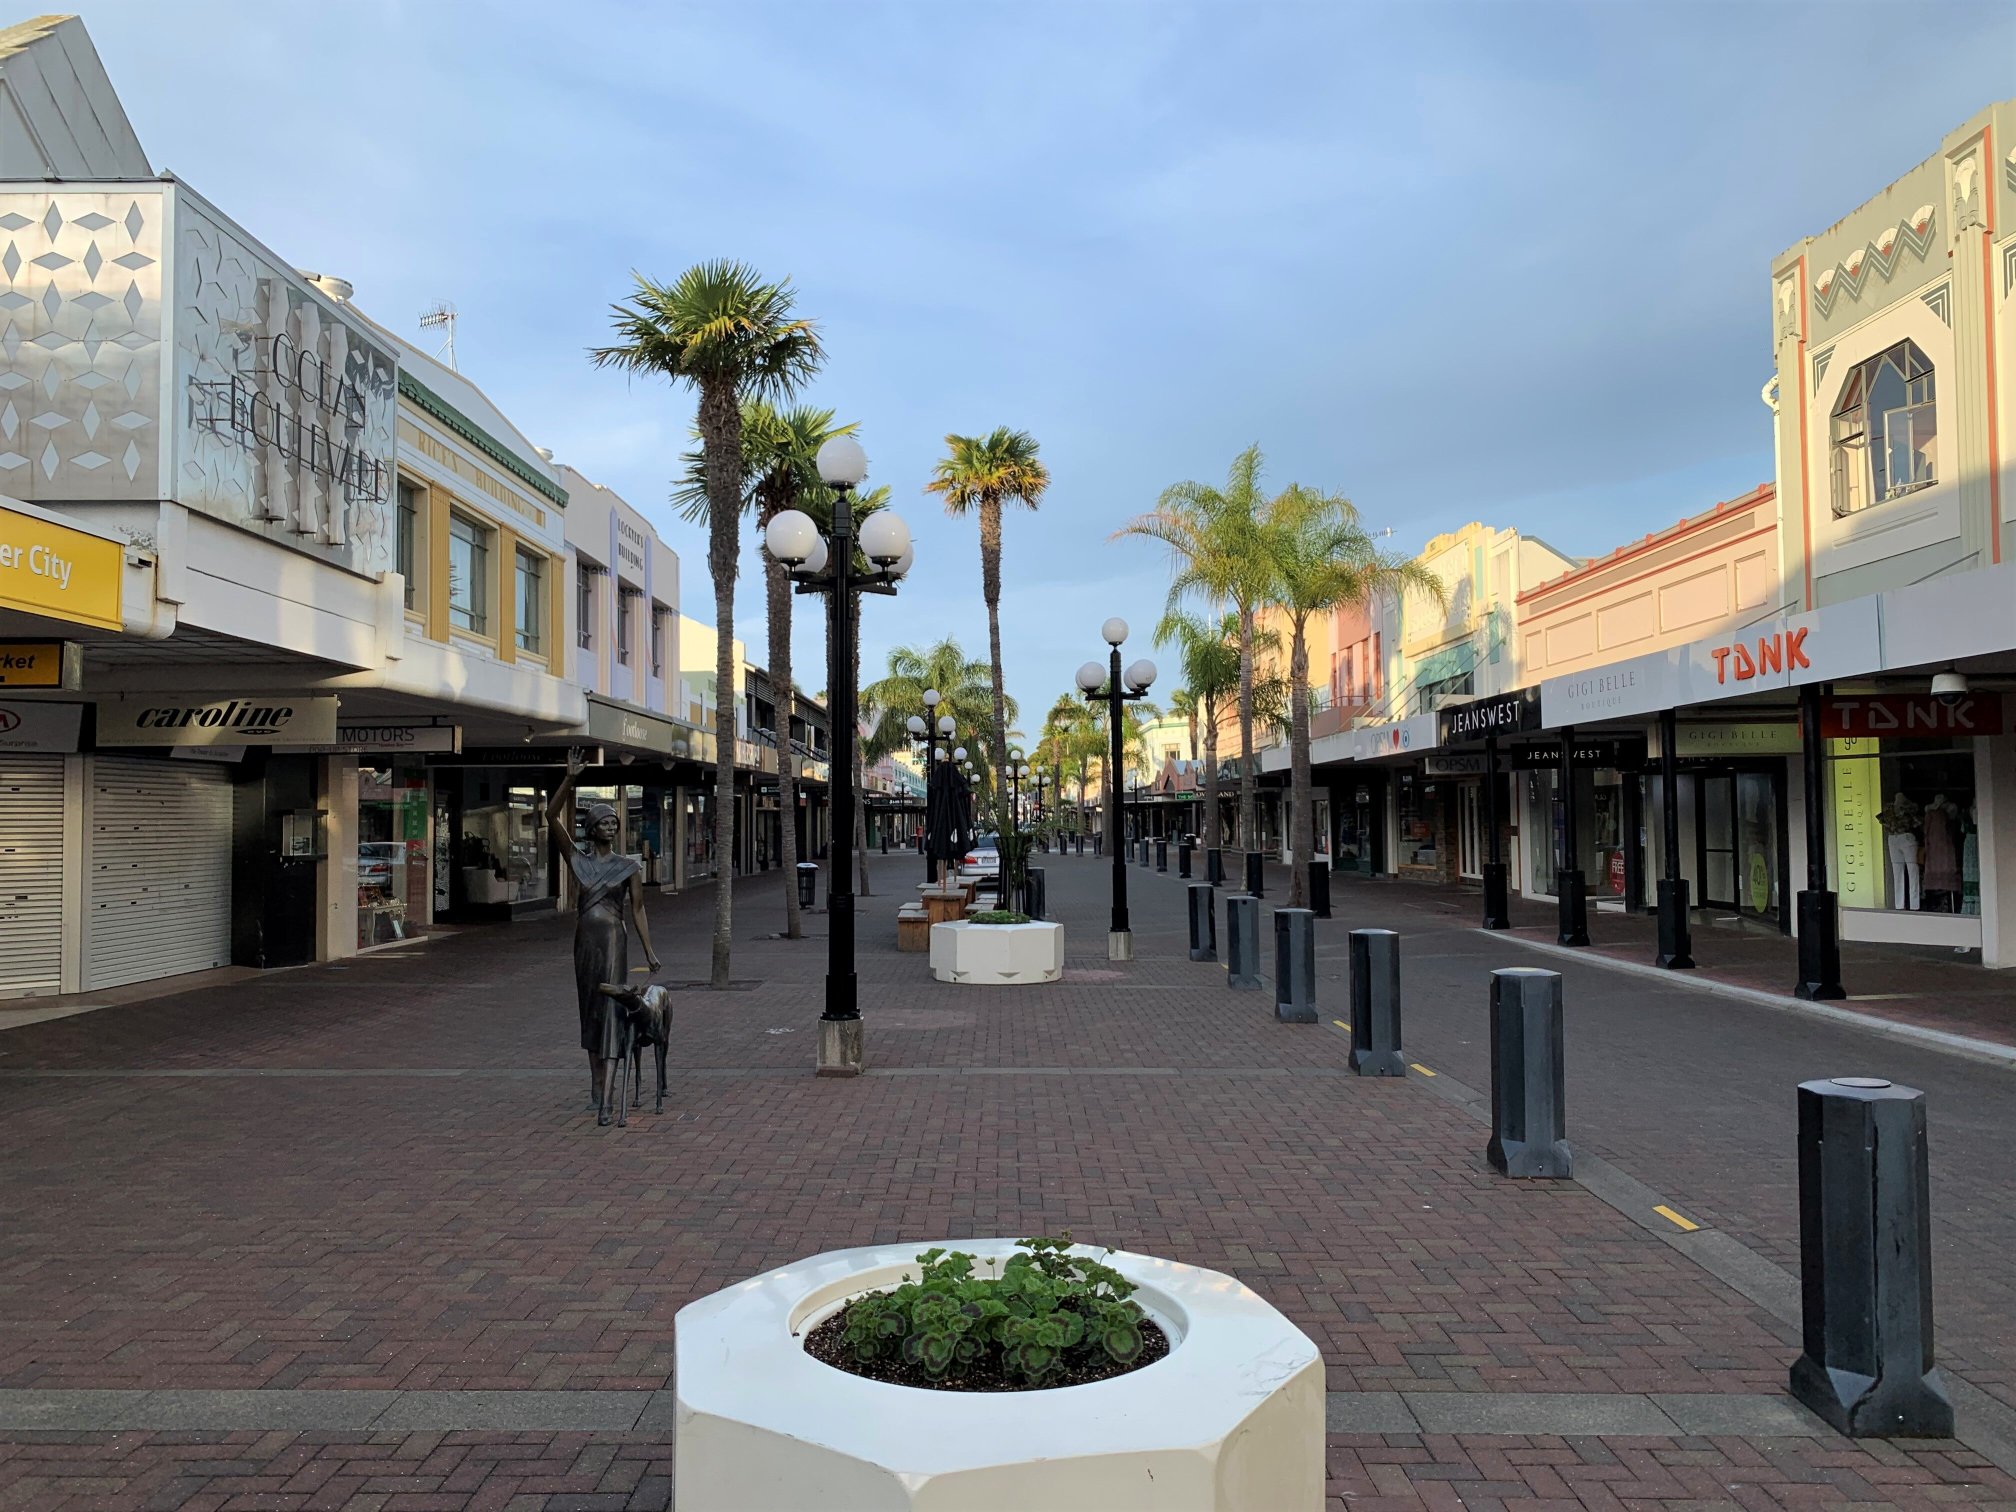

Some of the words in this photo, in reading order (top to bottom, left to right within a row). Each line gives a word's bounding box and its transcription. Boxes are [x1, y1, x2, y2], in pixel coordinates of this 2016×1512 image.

[273, 333, 366, 435] OCEAN
[231, 375, 391, 506] BOULEVARD
[475, 470, 533, 518] BUILDING
[29, 544, 72, 590] City
[618, 542, 644, 571] BUILDING
[1711, 626, 1811, 685] TANK
[1567, 680, 1595, 700] GIGI
[1599, 671, 1636, 694] BELLE
[135, 701, 294, 729] caroline
[1451, 700, 1520, 734] JEANSWEST
[1832, 701, 1975, 730] TANK
[342, 728, 415, 742] MOTORS
[1688, 730, 1724, 740] GIGI
[1731, 730, 1778, 740] BELLE
[1435, 756, 1480, 772] OPSM
[1527, 751, 1600, 760] JEANEST
[1842, 767, 1854, 831] BELLE
[1611, 860, 1625, 875] FREE
[1844, 843, 1856, 893] GIGI
